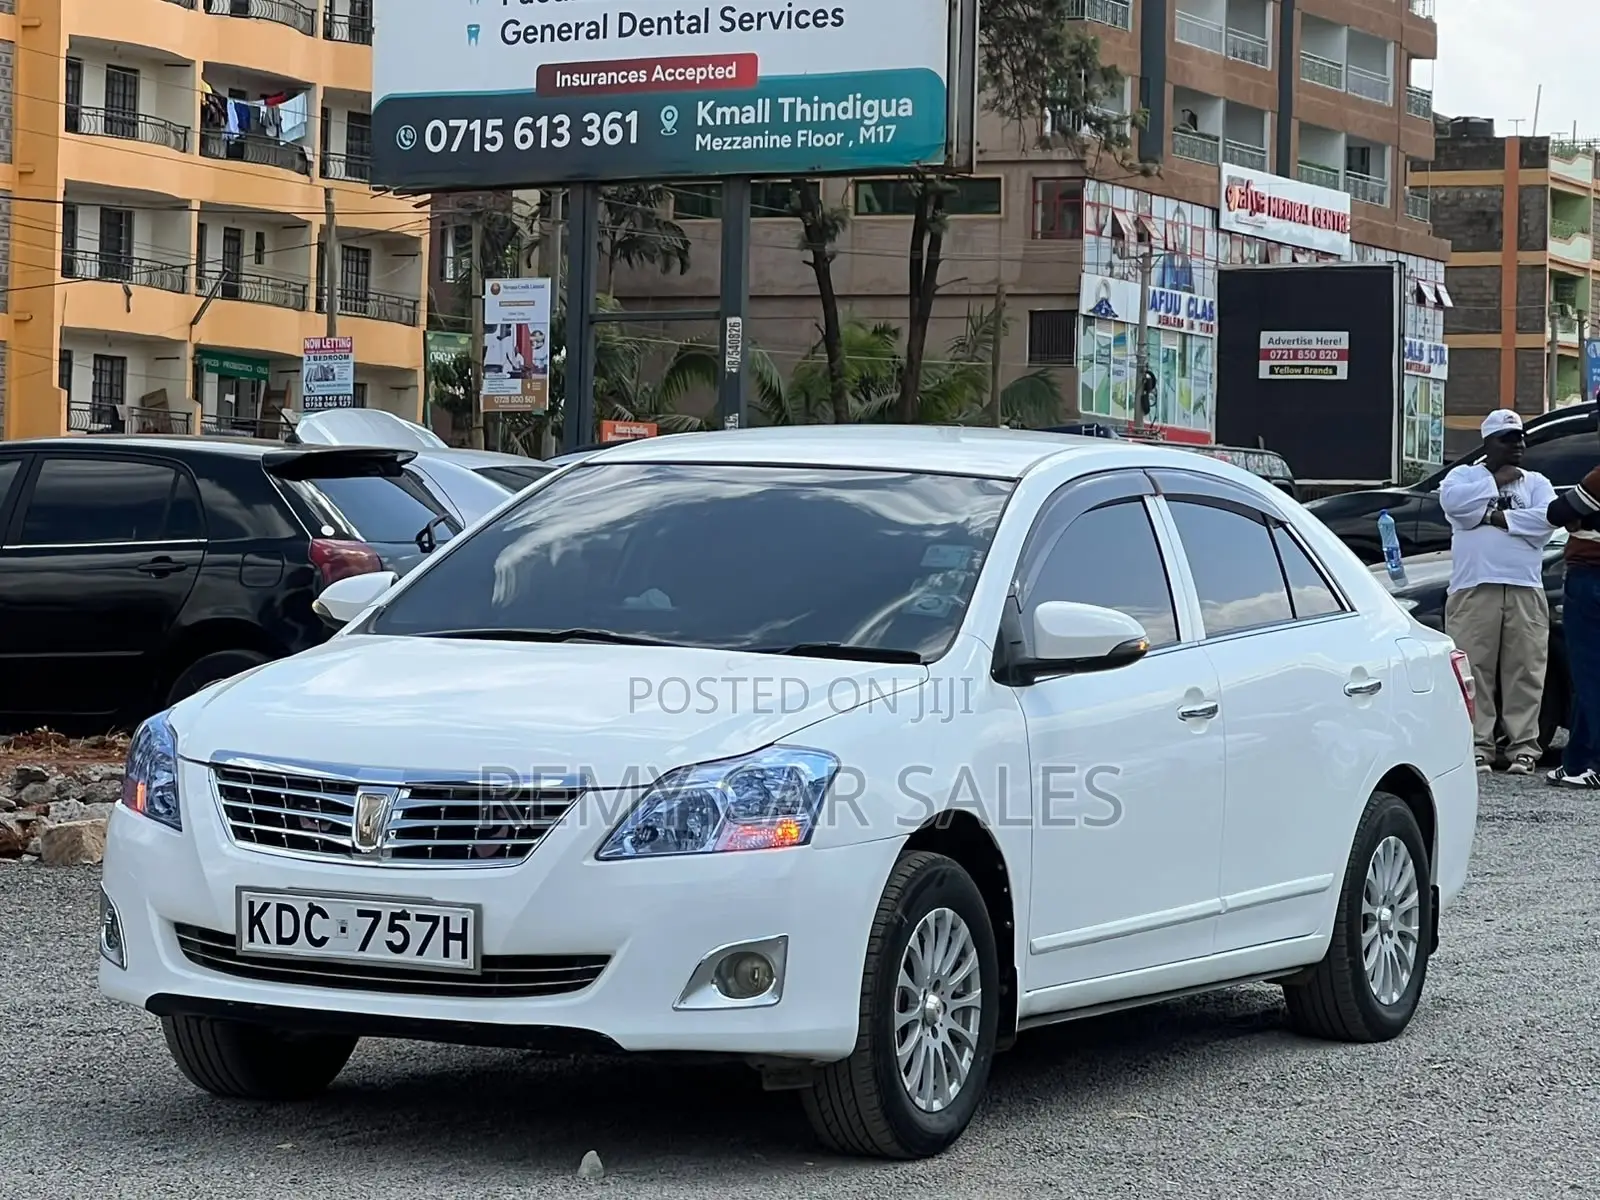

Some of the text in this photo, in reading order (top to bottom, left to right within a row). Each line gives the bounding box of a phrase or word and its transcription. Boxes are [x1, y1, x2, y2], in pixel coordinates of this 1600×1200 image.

[501, 2, 844, 46] General Dental Services
[556, 62, 736, 88] Insurances Accepted
[697, 93, 913, 126] Kmall Thindigua
[424, 110, 638, 153] 0715 613 361
[695, 130, 791, 151] Mezzanine
[859, 125, 897, 144] M17
[1268, 195, 1313, 227] MEDICAL
[1312, 206, 1351, 234] CENTRE
[304, 338, 352, 349] NOW LETTING
[1268, 336, 1342, 346] Advertise Here!
[313, 354, 350, 362] BEDROOM
[1270, 350, 1338, 360] 0721 850 820
[1274, 366, 1333, 375] Yellow Brands
[248, 900, 469, 960] KDC 757H
